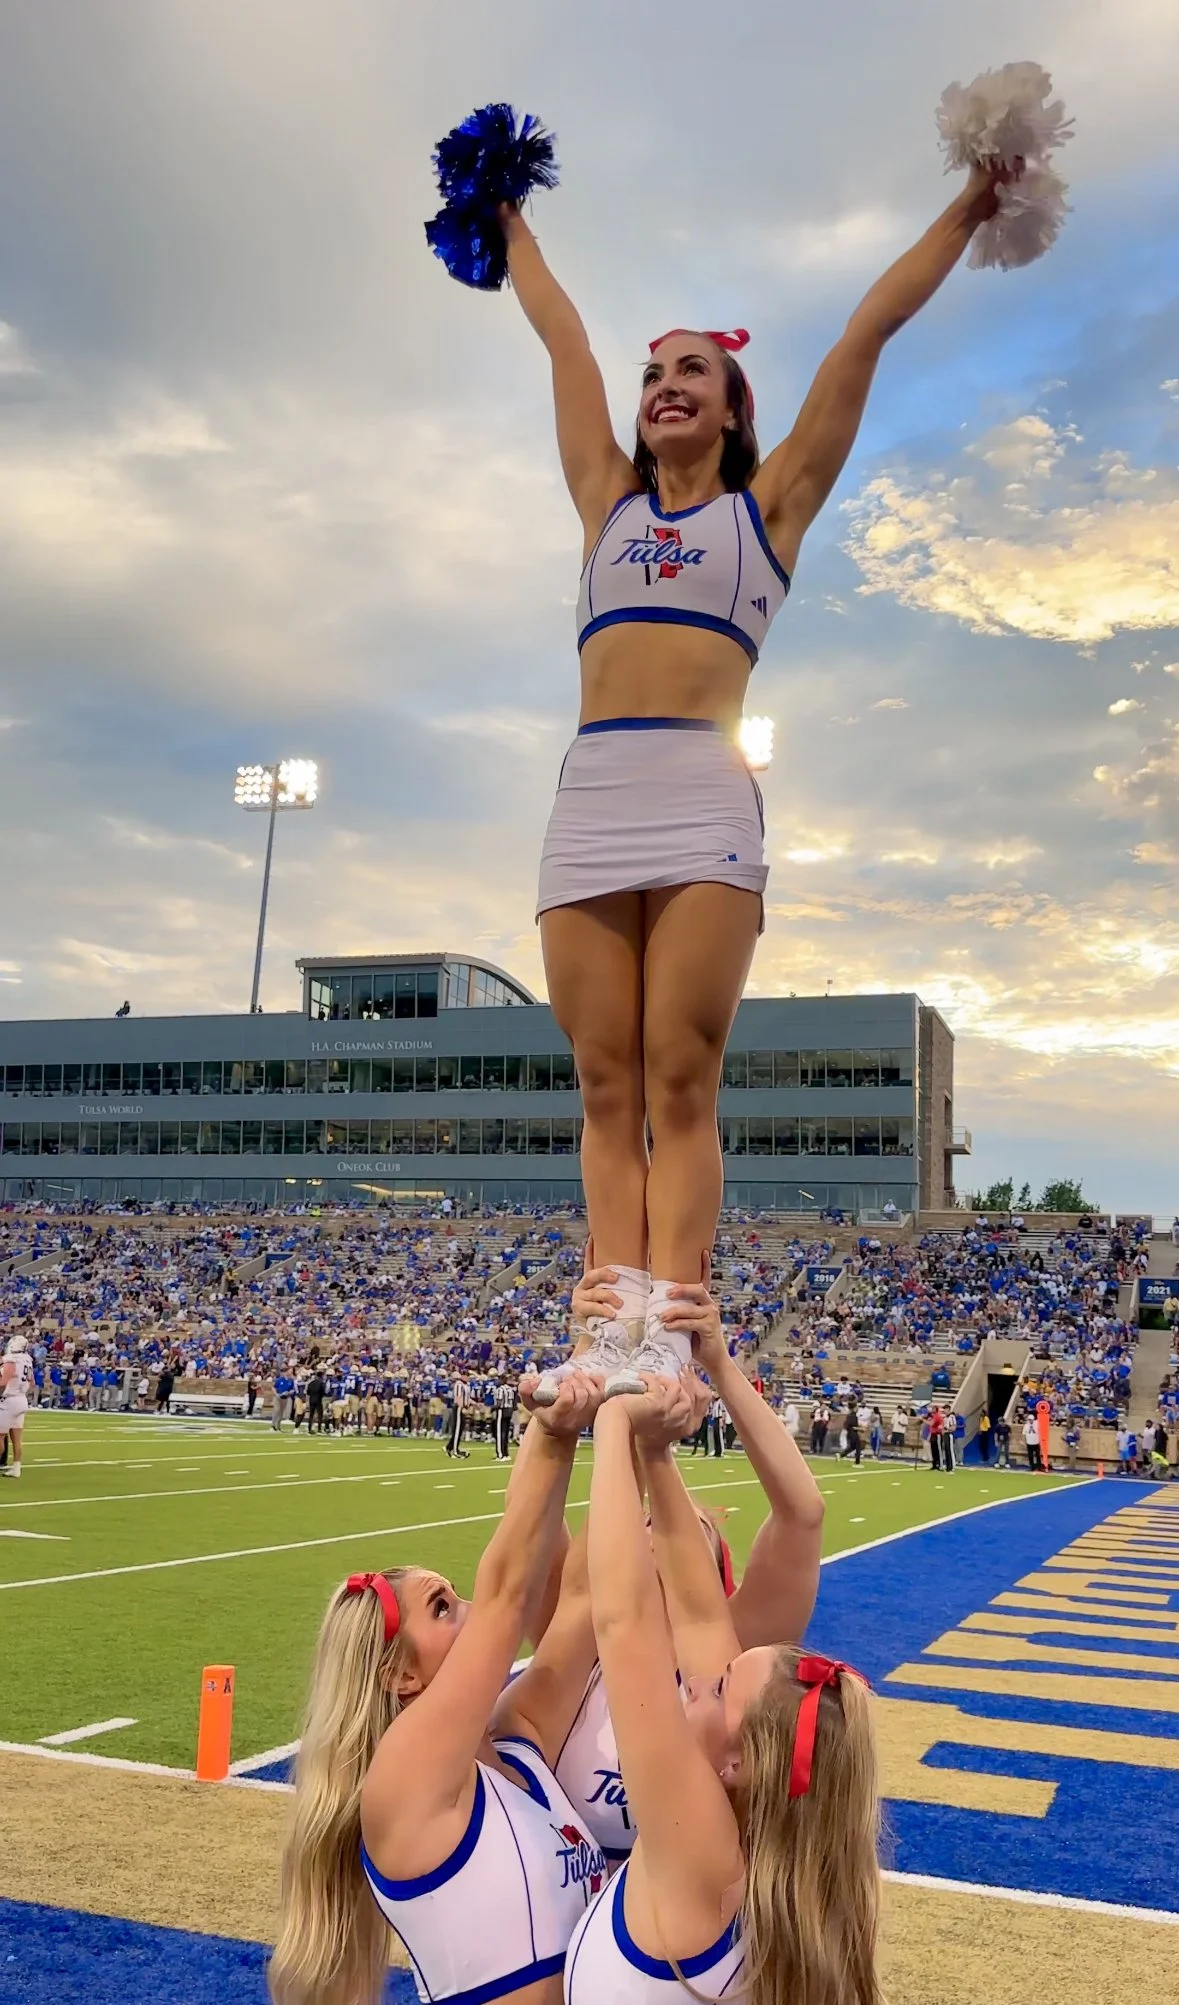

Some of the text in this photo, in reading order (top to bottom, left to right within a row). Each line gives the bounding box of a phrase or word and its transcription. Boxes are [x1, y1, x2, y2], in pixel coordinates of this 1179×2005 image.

[610, 538, 708, 565] Tulsa
[311, 1040, 433, 1052] H.A. CHAPMAN STADIUM
[78, 1104, 144, 1115] TULSA WORLD
[375, 1161, 401, 1172] CLUB
[1146, 1285, 1171, 1295] 2021
[556, 1840, 607, 1888] Tulsa
